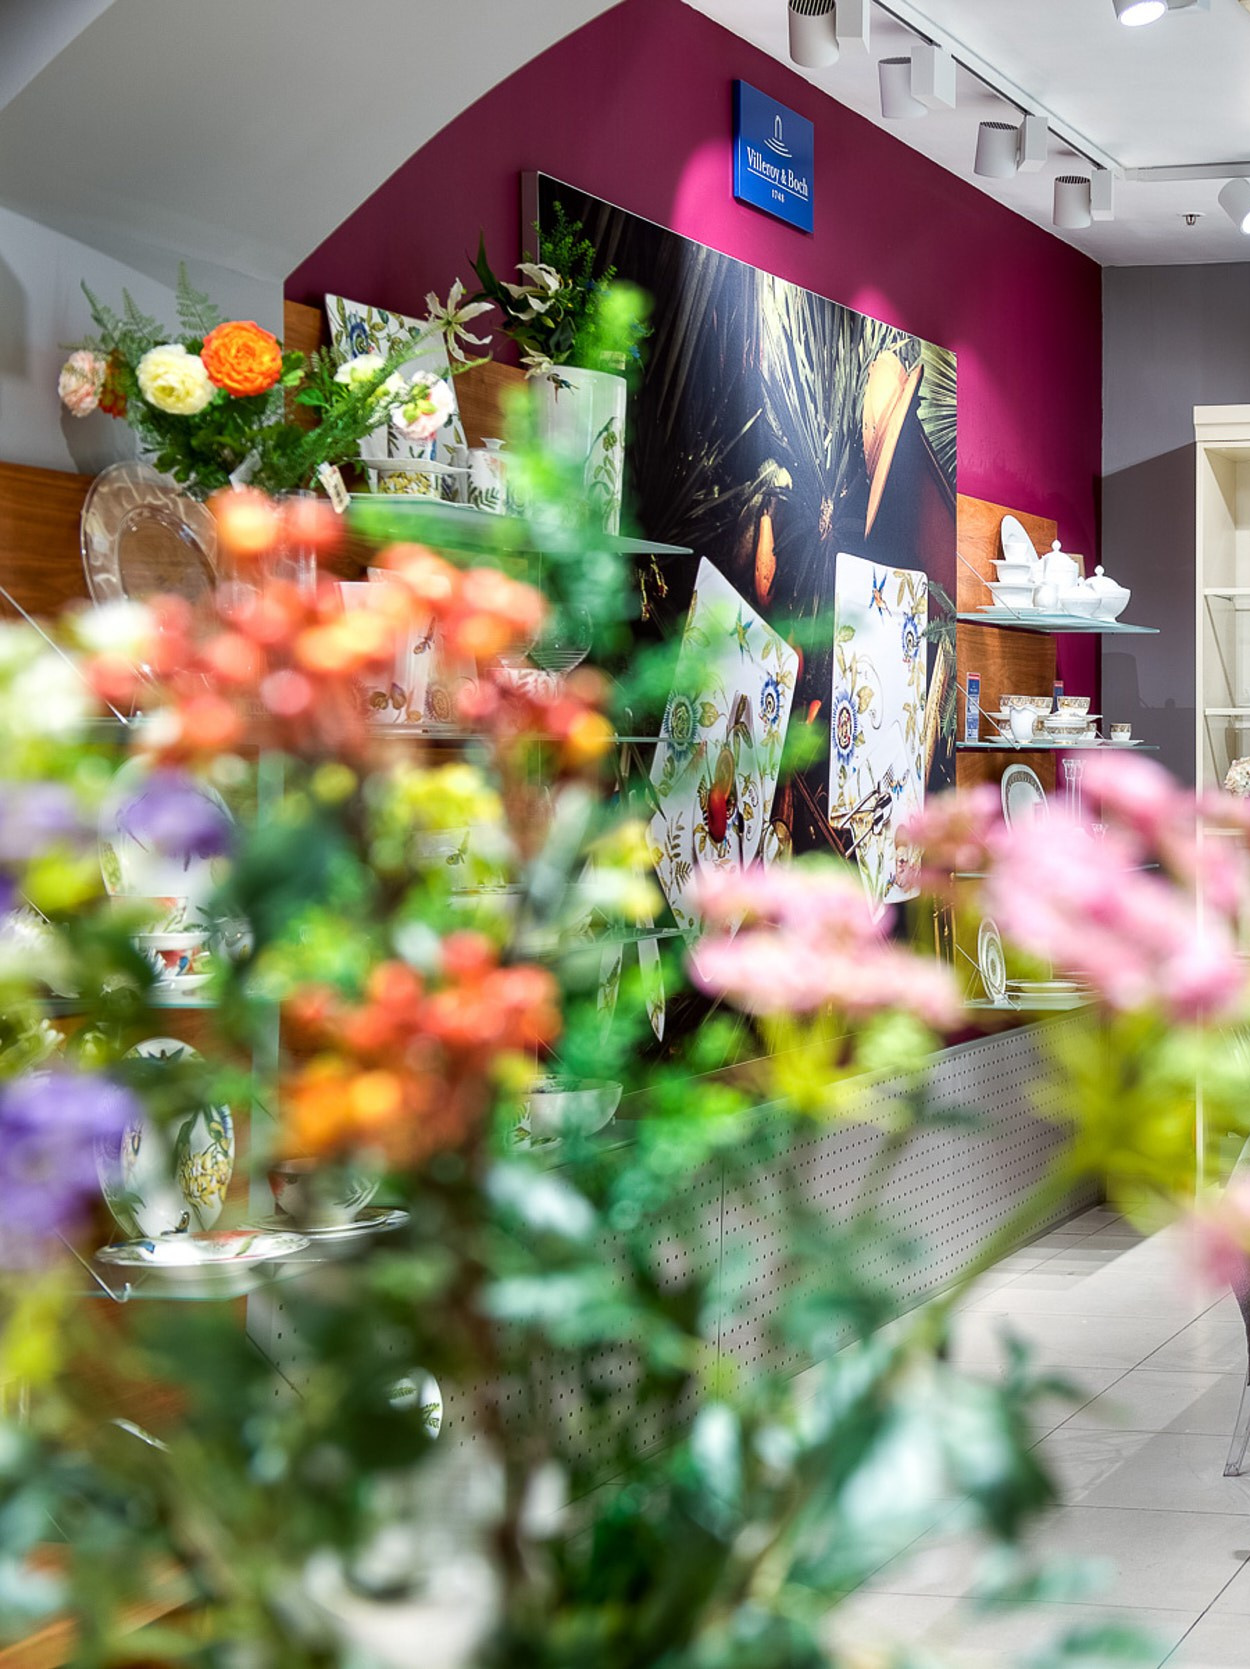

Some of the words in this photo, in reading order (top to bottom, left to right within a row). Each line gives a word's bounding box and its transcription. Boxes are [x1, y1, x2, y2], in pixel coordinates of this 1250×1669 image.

[746, 146, 779, 184] Villeroy
[780, 169, 787, 185] &
[788, 169, 809, 197] Boch
